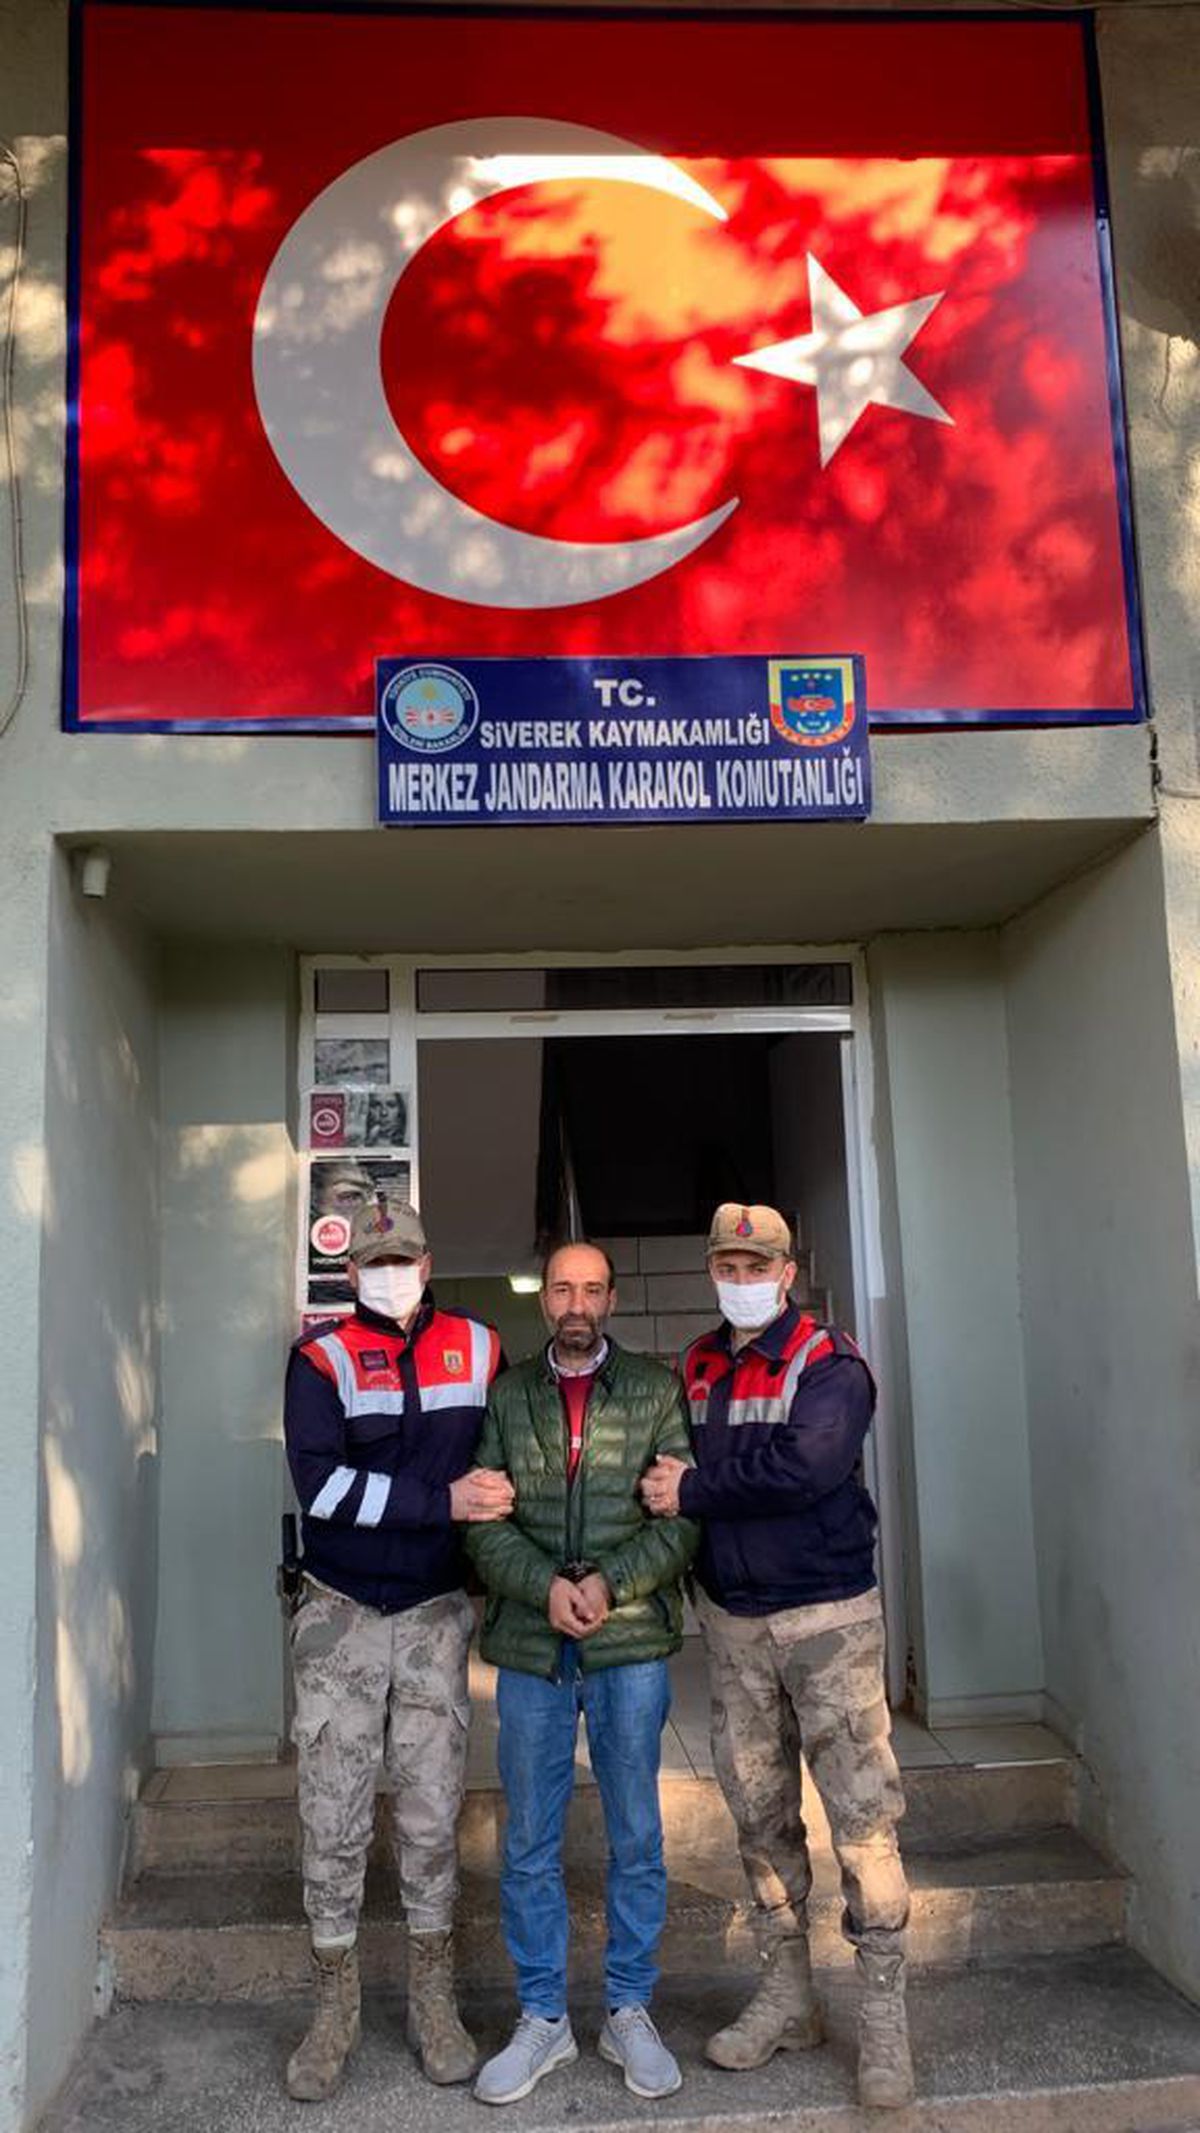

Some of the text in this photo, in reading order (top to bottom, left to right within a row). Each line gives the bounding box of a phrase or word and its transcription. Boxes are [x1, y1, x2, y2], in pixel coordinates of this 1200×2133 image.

[588, 712, 770, 748] KAYMAKAMLIĞI
[389, 746, 864, 811] MERKEZ JANDARMA KARAKOL KOMUTANLIĞI
